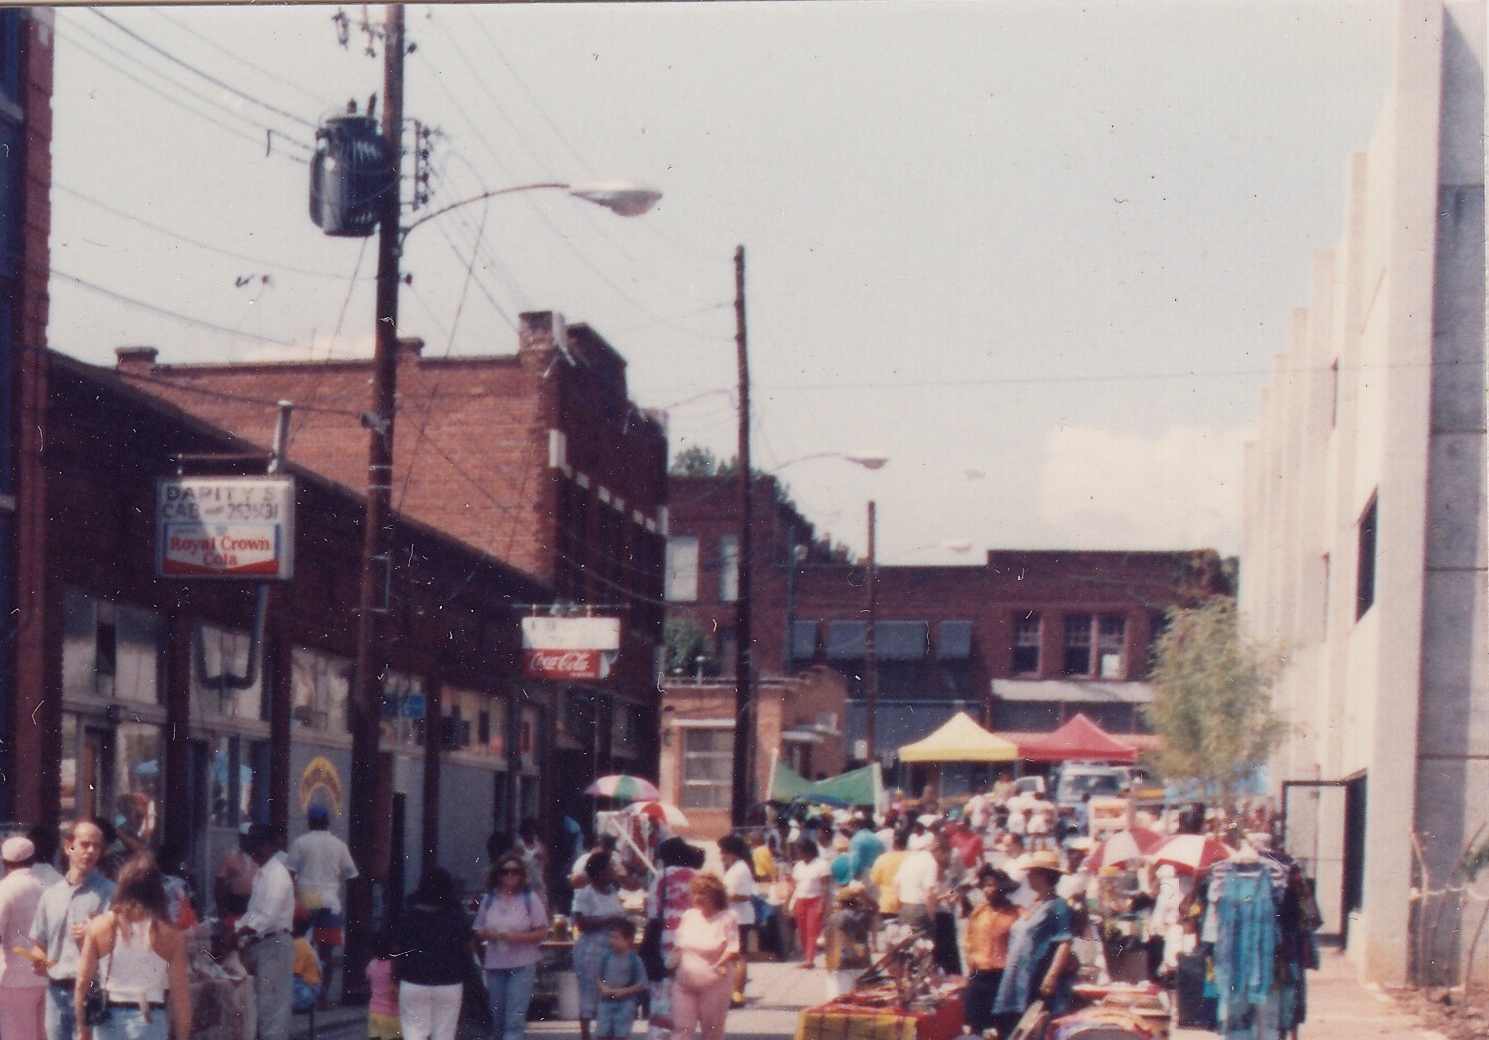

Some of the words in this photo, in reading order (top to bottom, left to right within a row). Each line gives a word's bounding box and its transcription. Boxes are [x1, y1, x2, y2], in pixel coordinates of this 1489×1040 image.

[170, 535, 215, 556] Royal
[221, 535, 270, 551] Crown
[203, 551, 237, 566] Cola
